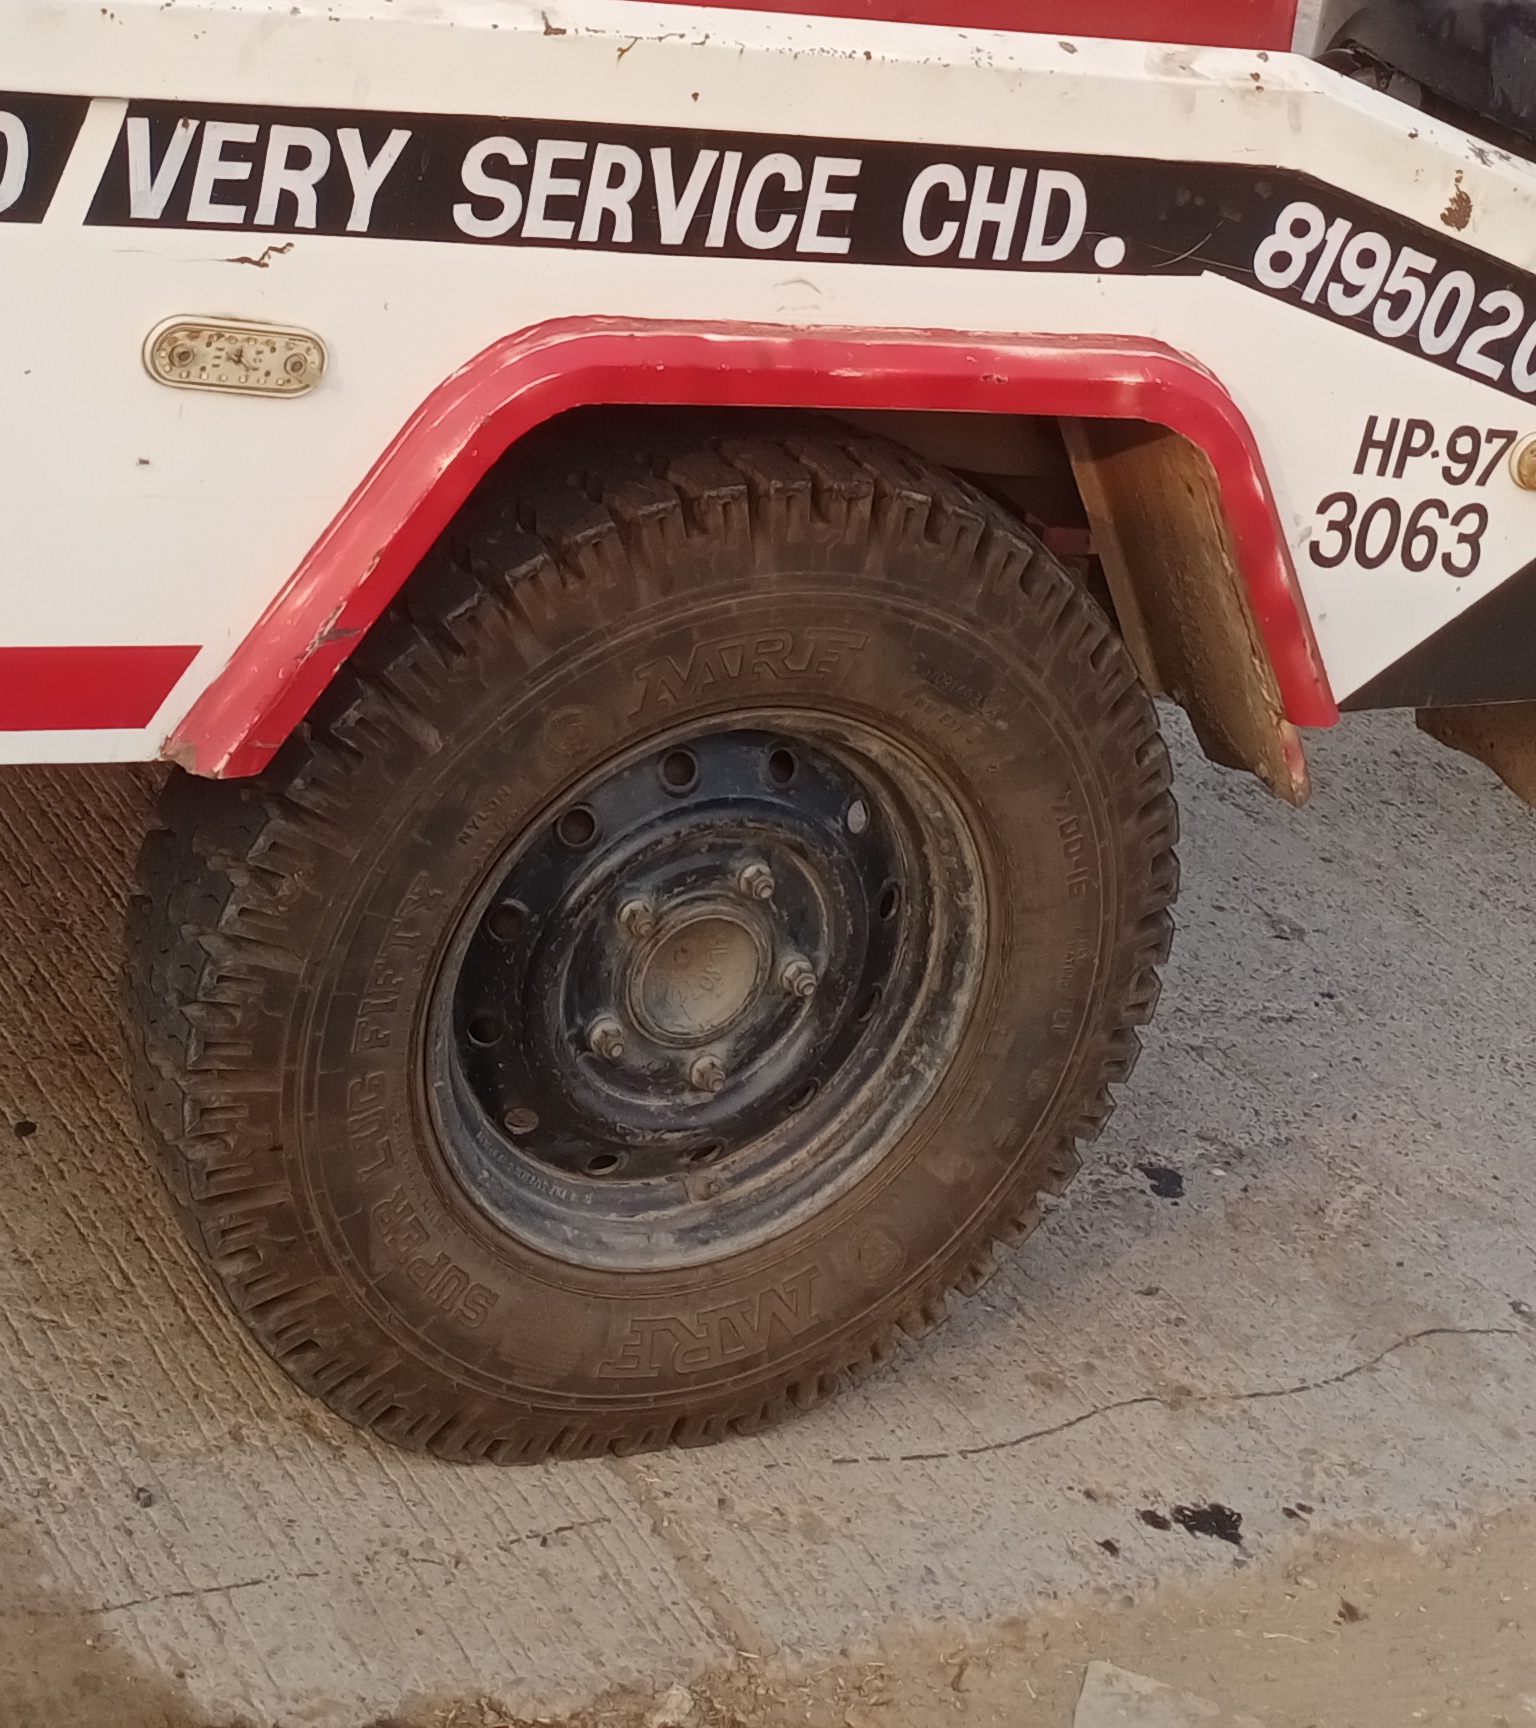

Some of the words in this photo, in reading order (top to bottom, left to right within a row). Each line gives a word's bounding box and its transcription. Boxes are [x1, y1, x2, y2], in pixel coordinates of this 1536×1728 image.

[125, 117, 413, 233] VERY
[452, 135, 863, 256] SERVICE
[901, 163, 1127, 269] CHD.
[1309, 491, 1489, 579] 3063
[627, 626, 869, 723] MRF
[350, 869, 444, 1055] FIFTY
[348, 1070, 397, 1186] LUG
[372, 1185, 501, 1329] SUPER
[596, 1264, 822, 1380] MRF
